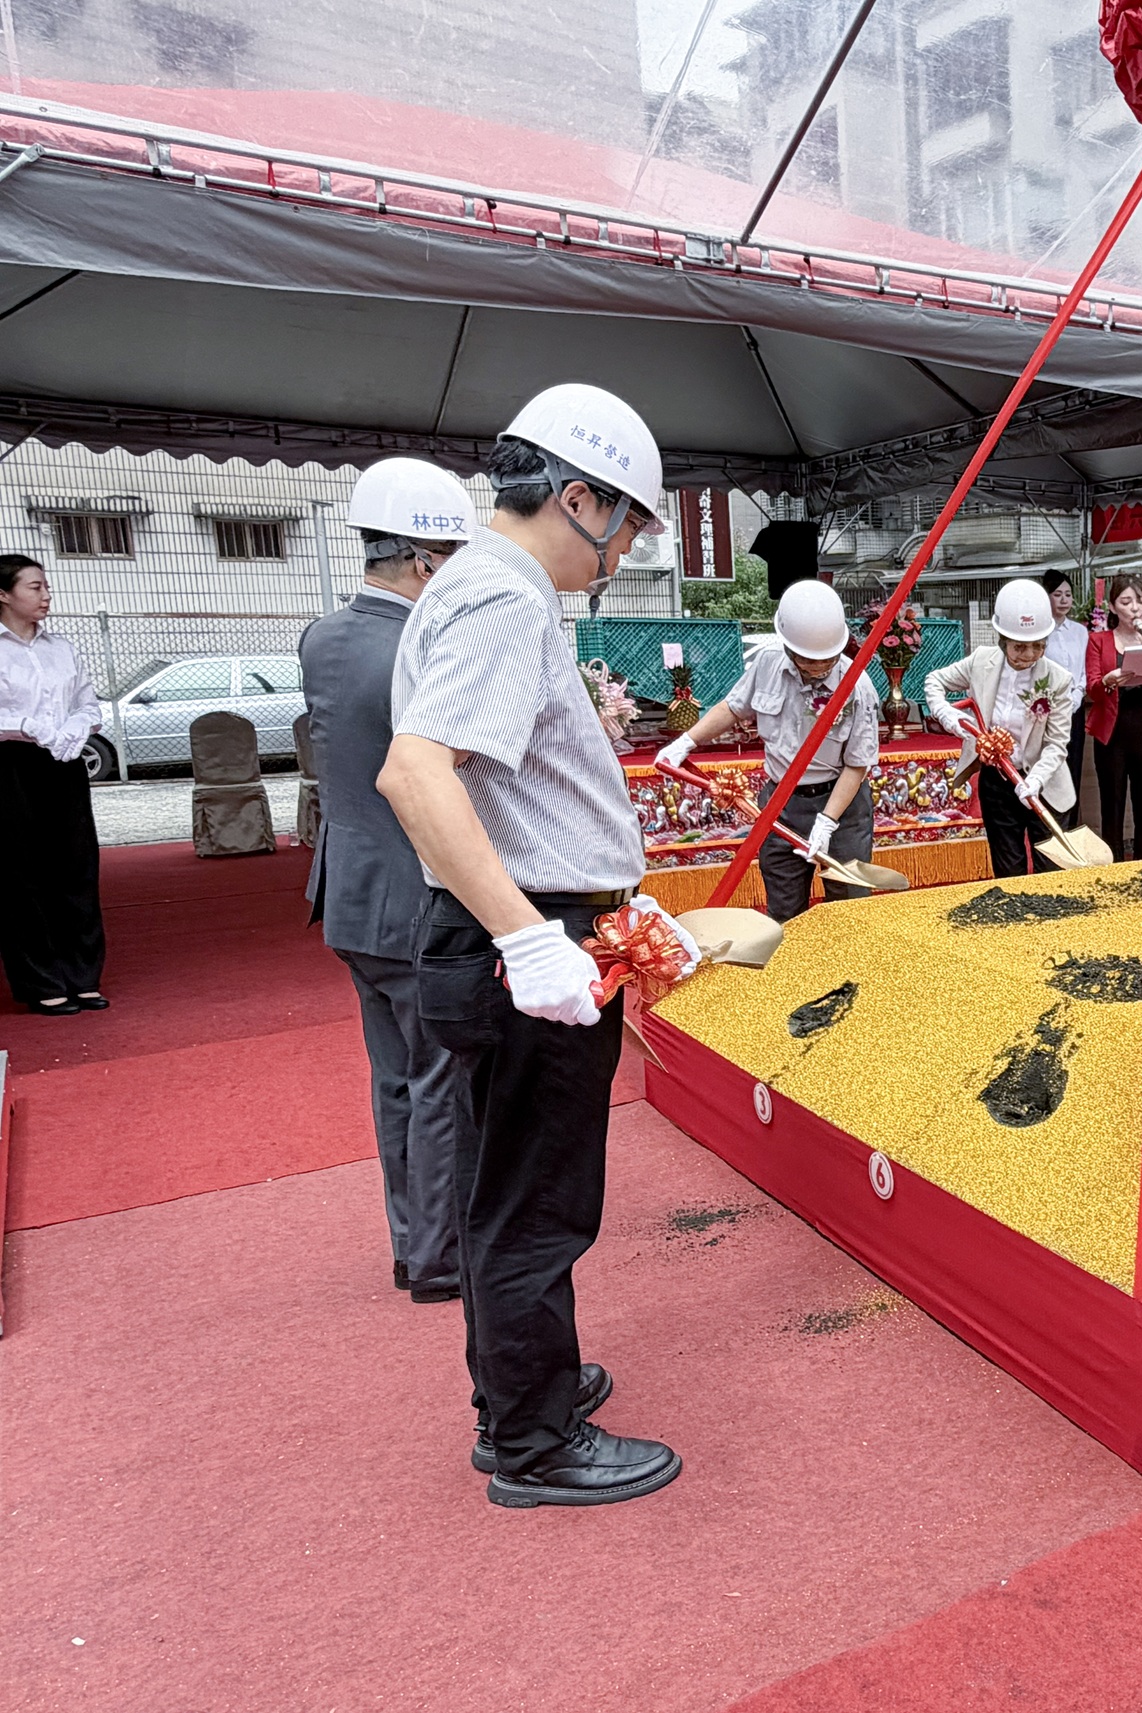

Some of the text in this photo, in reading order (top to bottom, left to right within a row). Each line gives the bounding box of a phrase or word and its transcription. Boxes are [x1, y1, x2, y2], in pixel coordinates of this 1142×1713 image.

[411, 512, 466, 533] 林中文
[876, 1162, 885, 1189] 6
